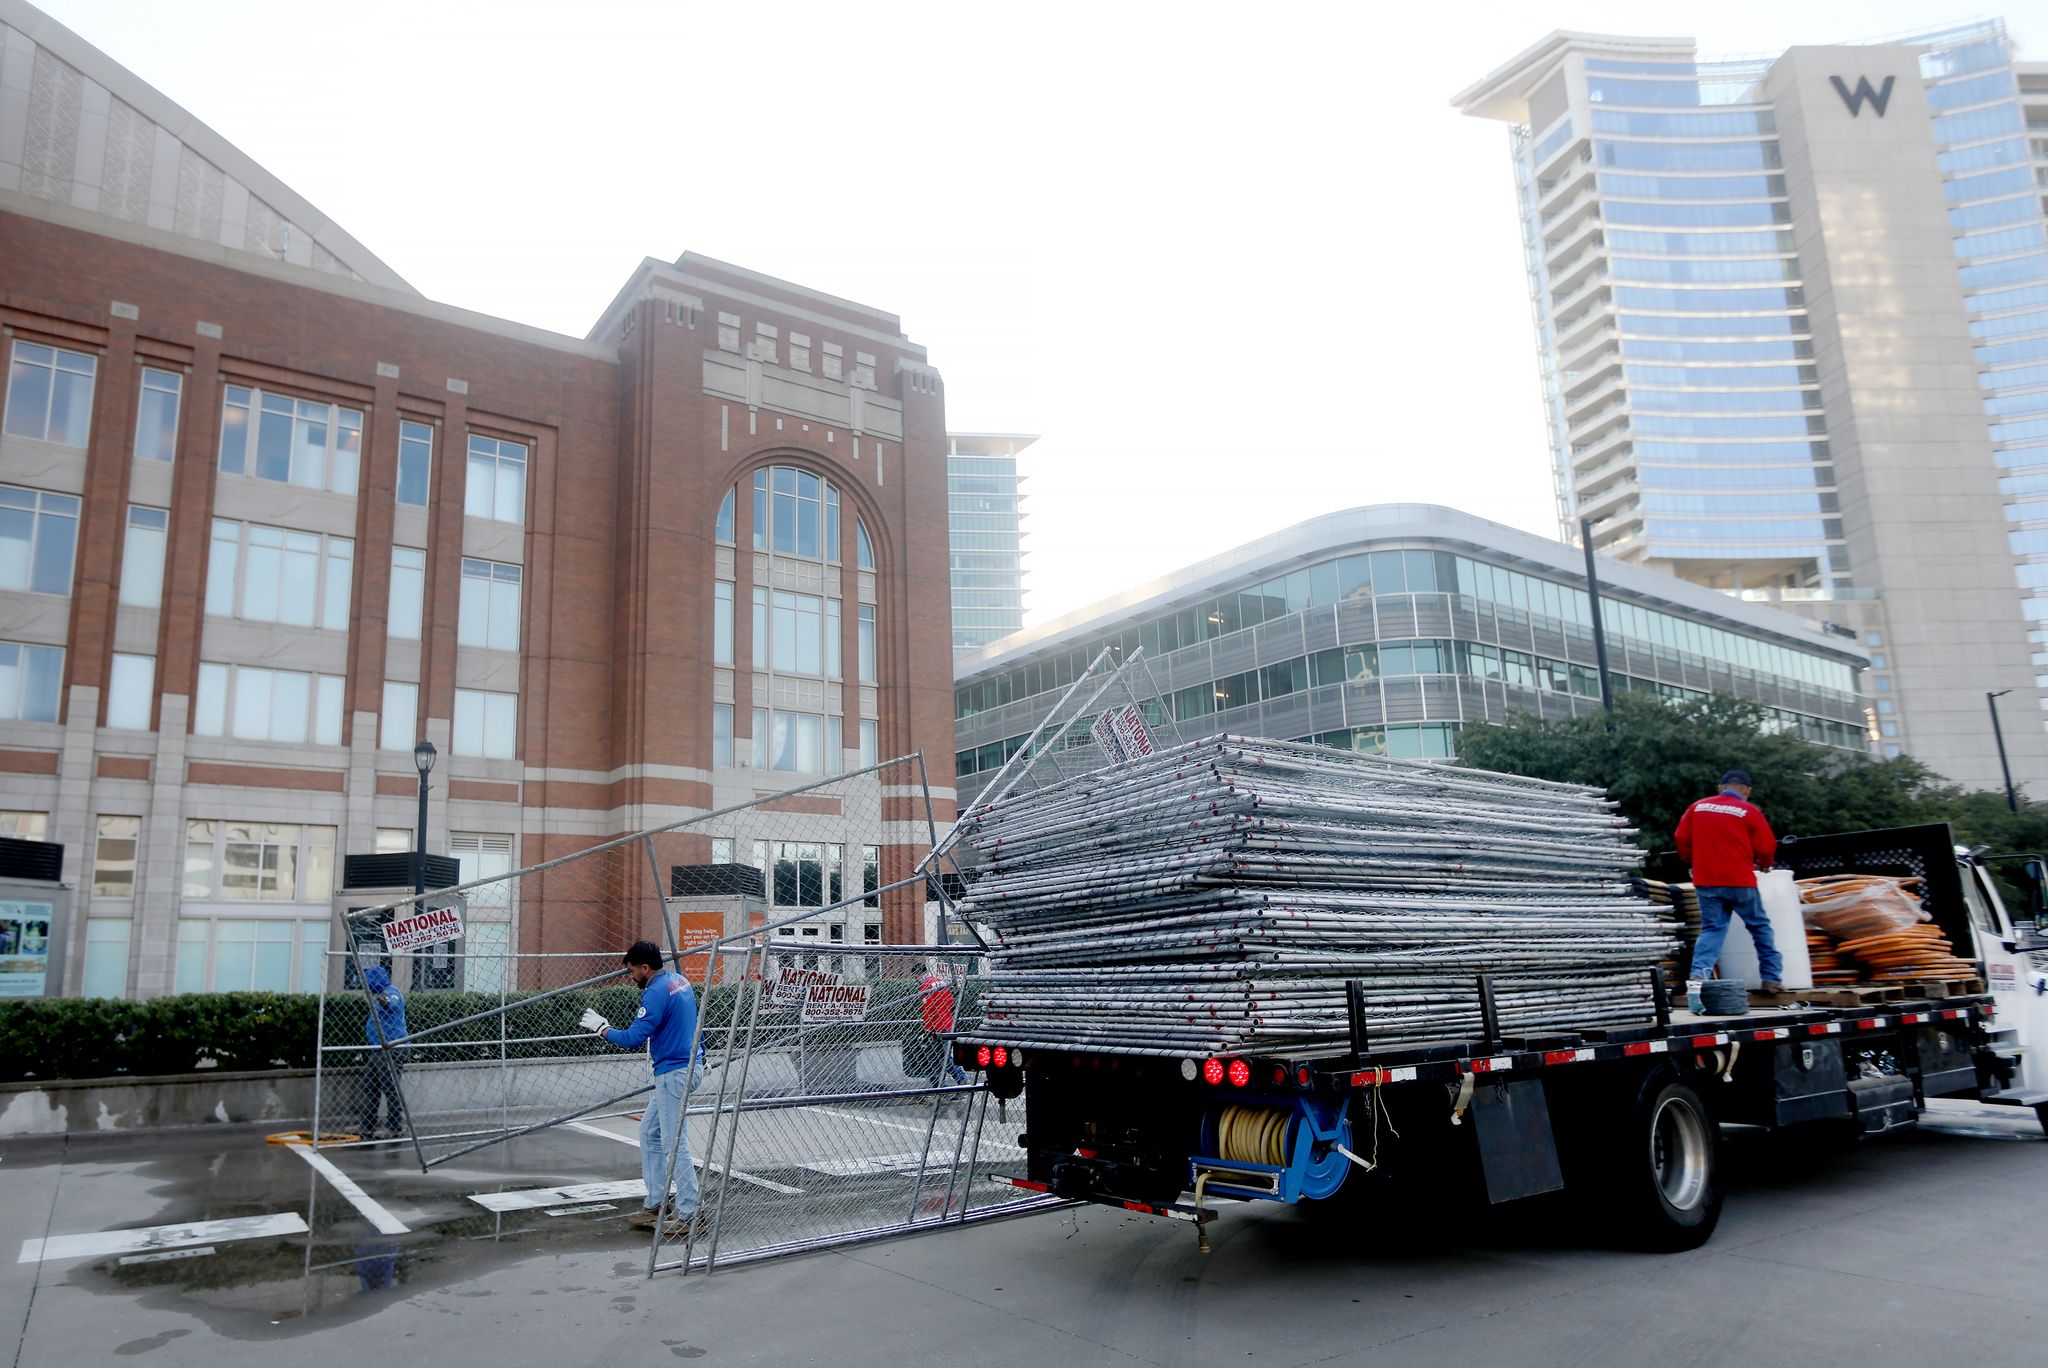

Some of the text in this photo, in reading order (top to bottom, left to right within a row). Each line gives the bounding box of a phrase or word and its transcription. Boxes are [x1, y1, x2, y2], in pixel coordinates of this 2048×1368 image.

[1829, 75, 1895, 118] W
[385, 909, 458, 939] NATIONAL
[389, 922, 459, 944] RENT-A-FENCE
[391, 928, 460, 950] 800-352-5675
[808, 986, 867, 1003] NATIONAL
[805, 1008, 864, 1016] 800-352-5675
